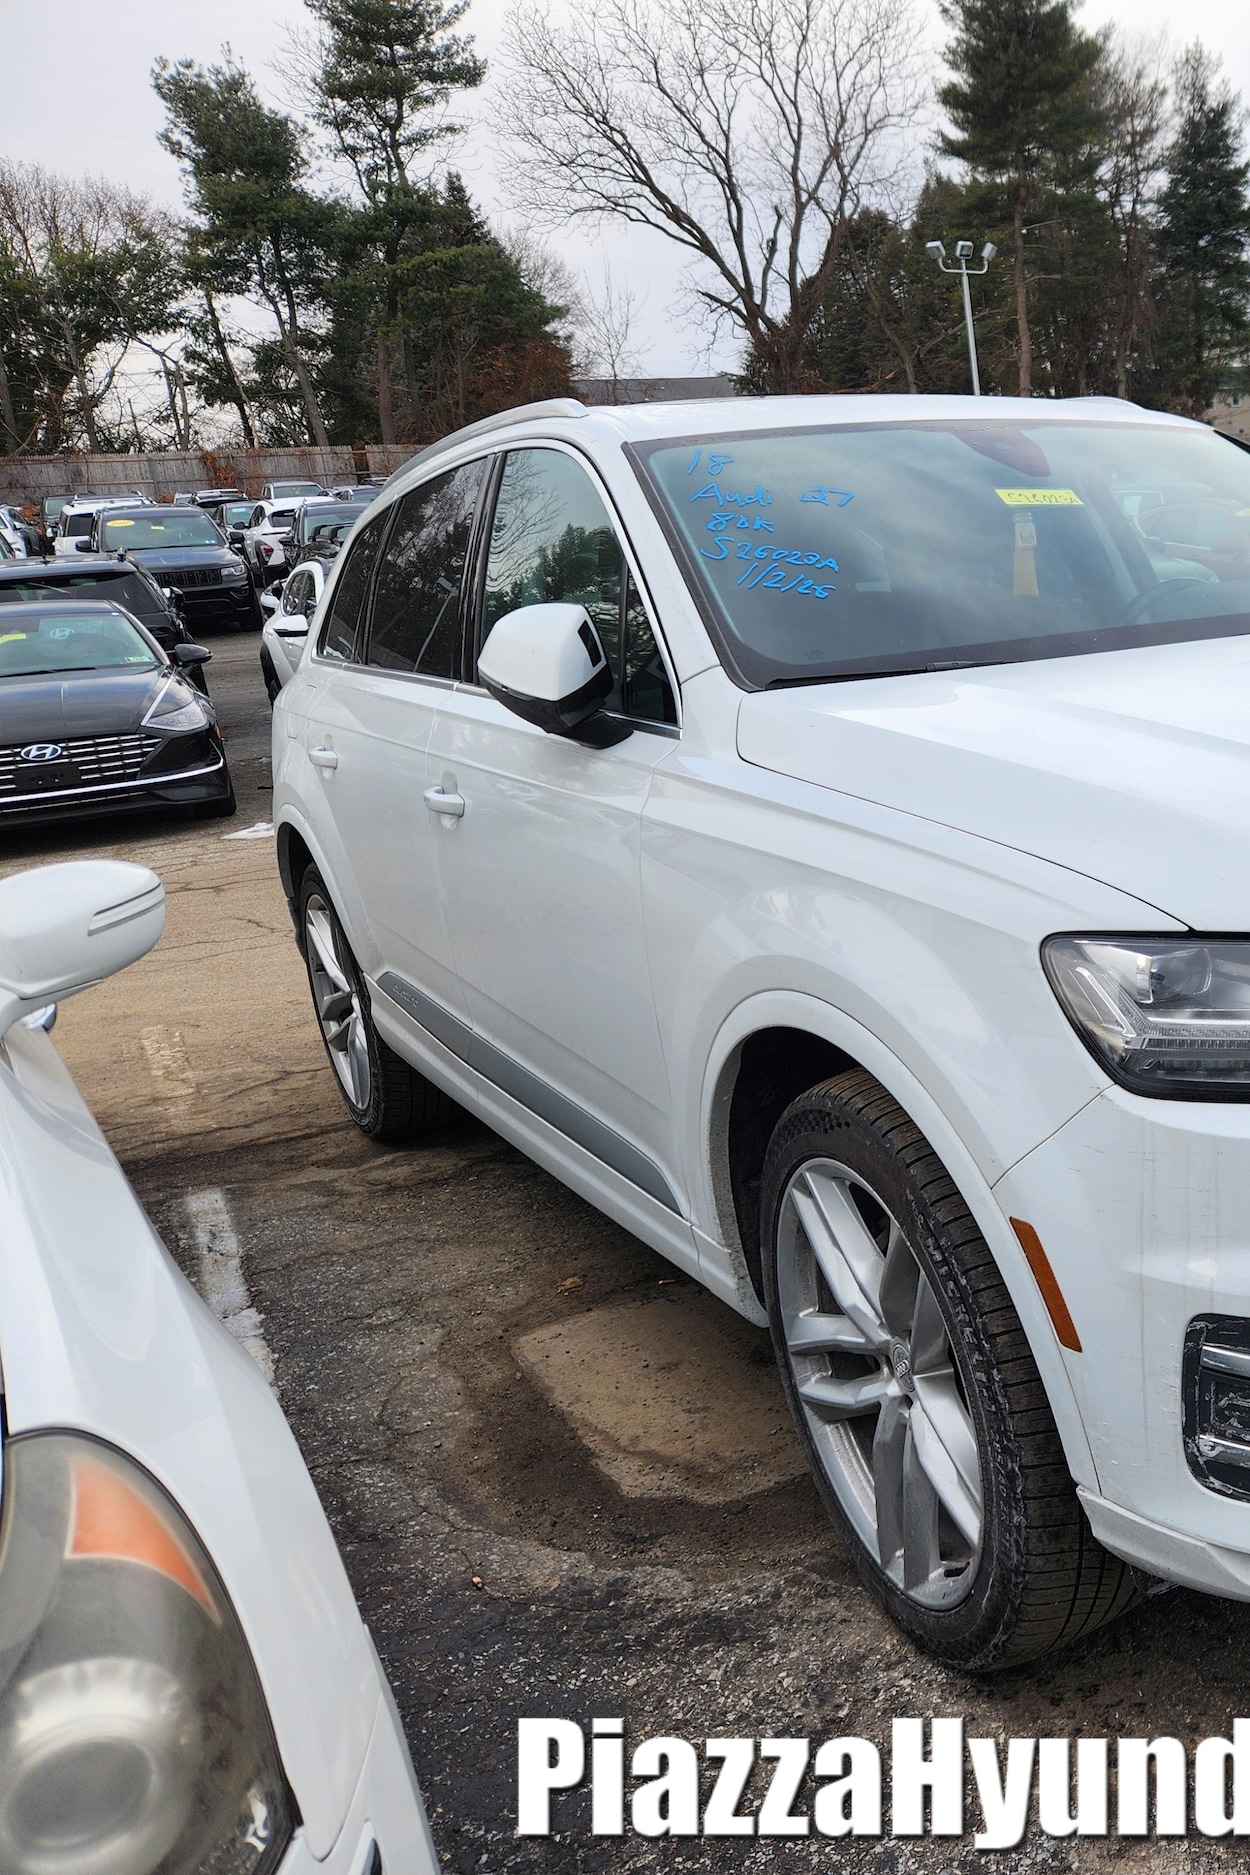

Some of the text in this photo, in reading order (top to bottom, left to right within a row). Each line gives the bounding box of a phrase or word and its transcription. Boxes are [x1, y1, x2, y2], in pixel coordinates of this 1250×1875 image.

[687, 449, 735, 475] 18
[691, 482, 773, 506] Audi
[700, 536, 839, 573] S26023A
[737, 562, 836, 599] 1/2/26
